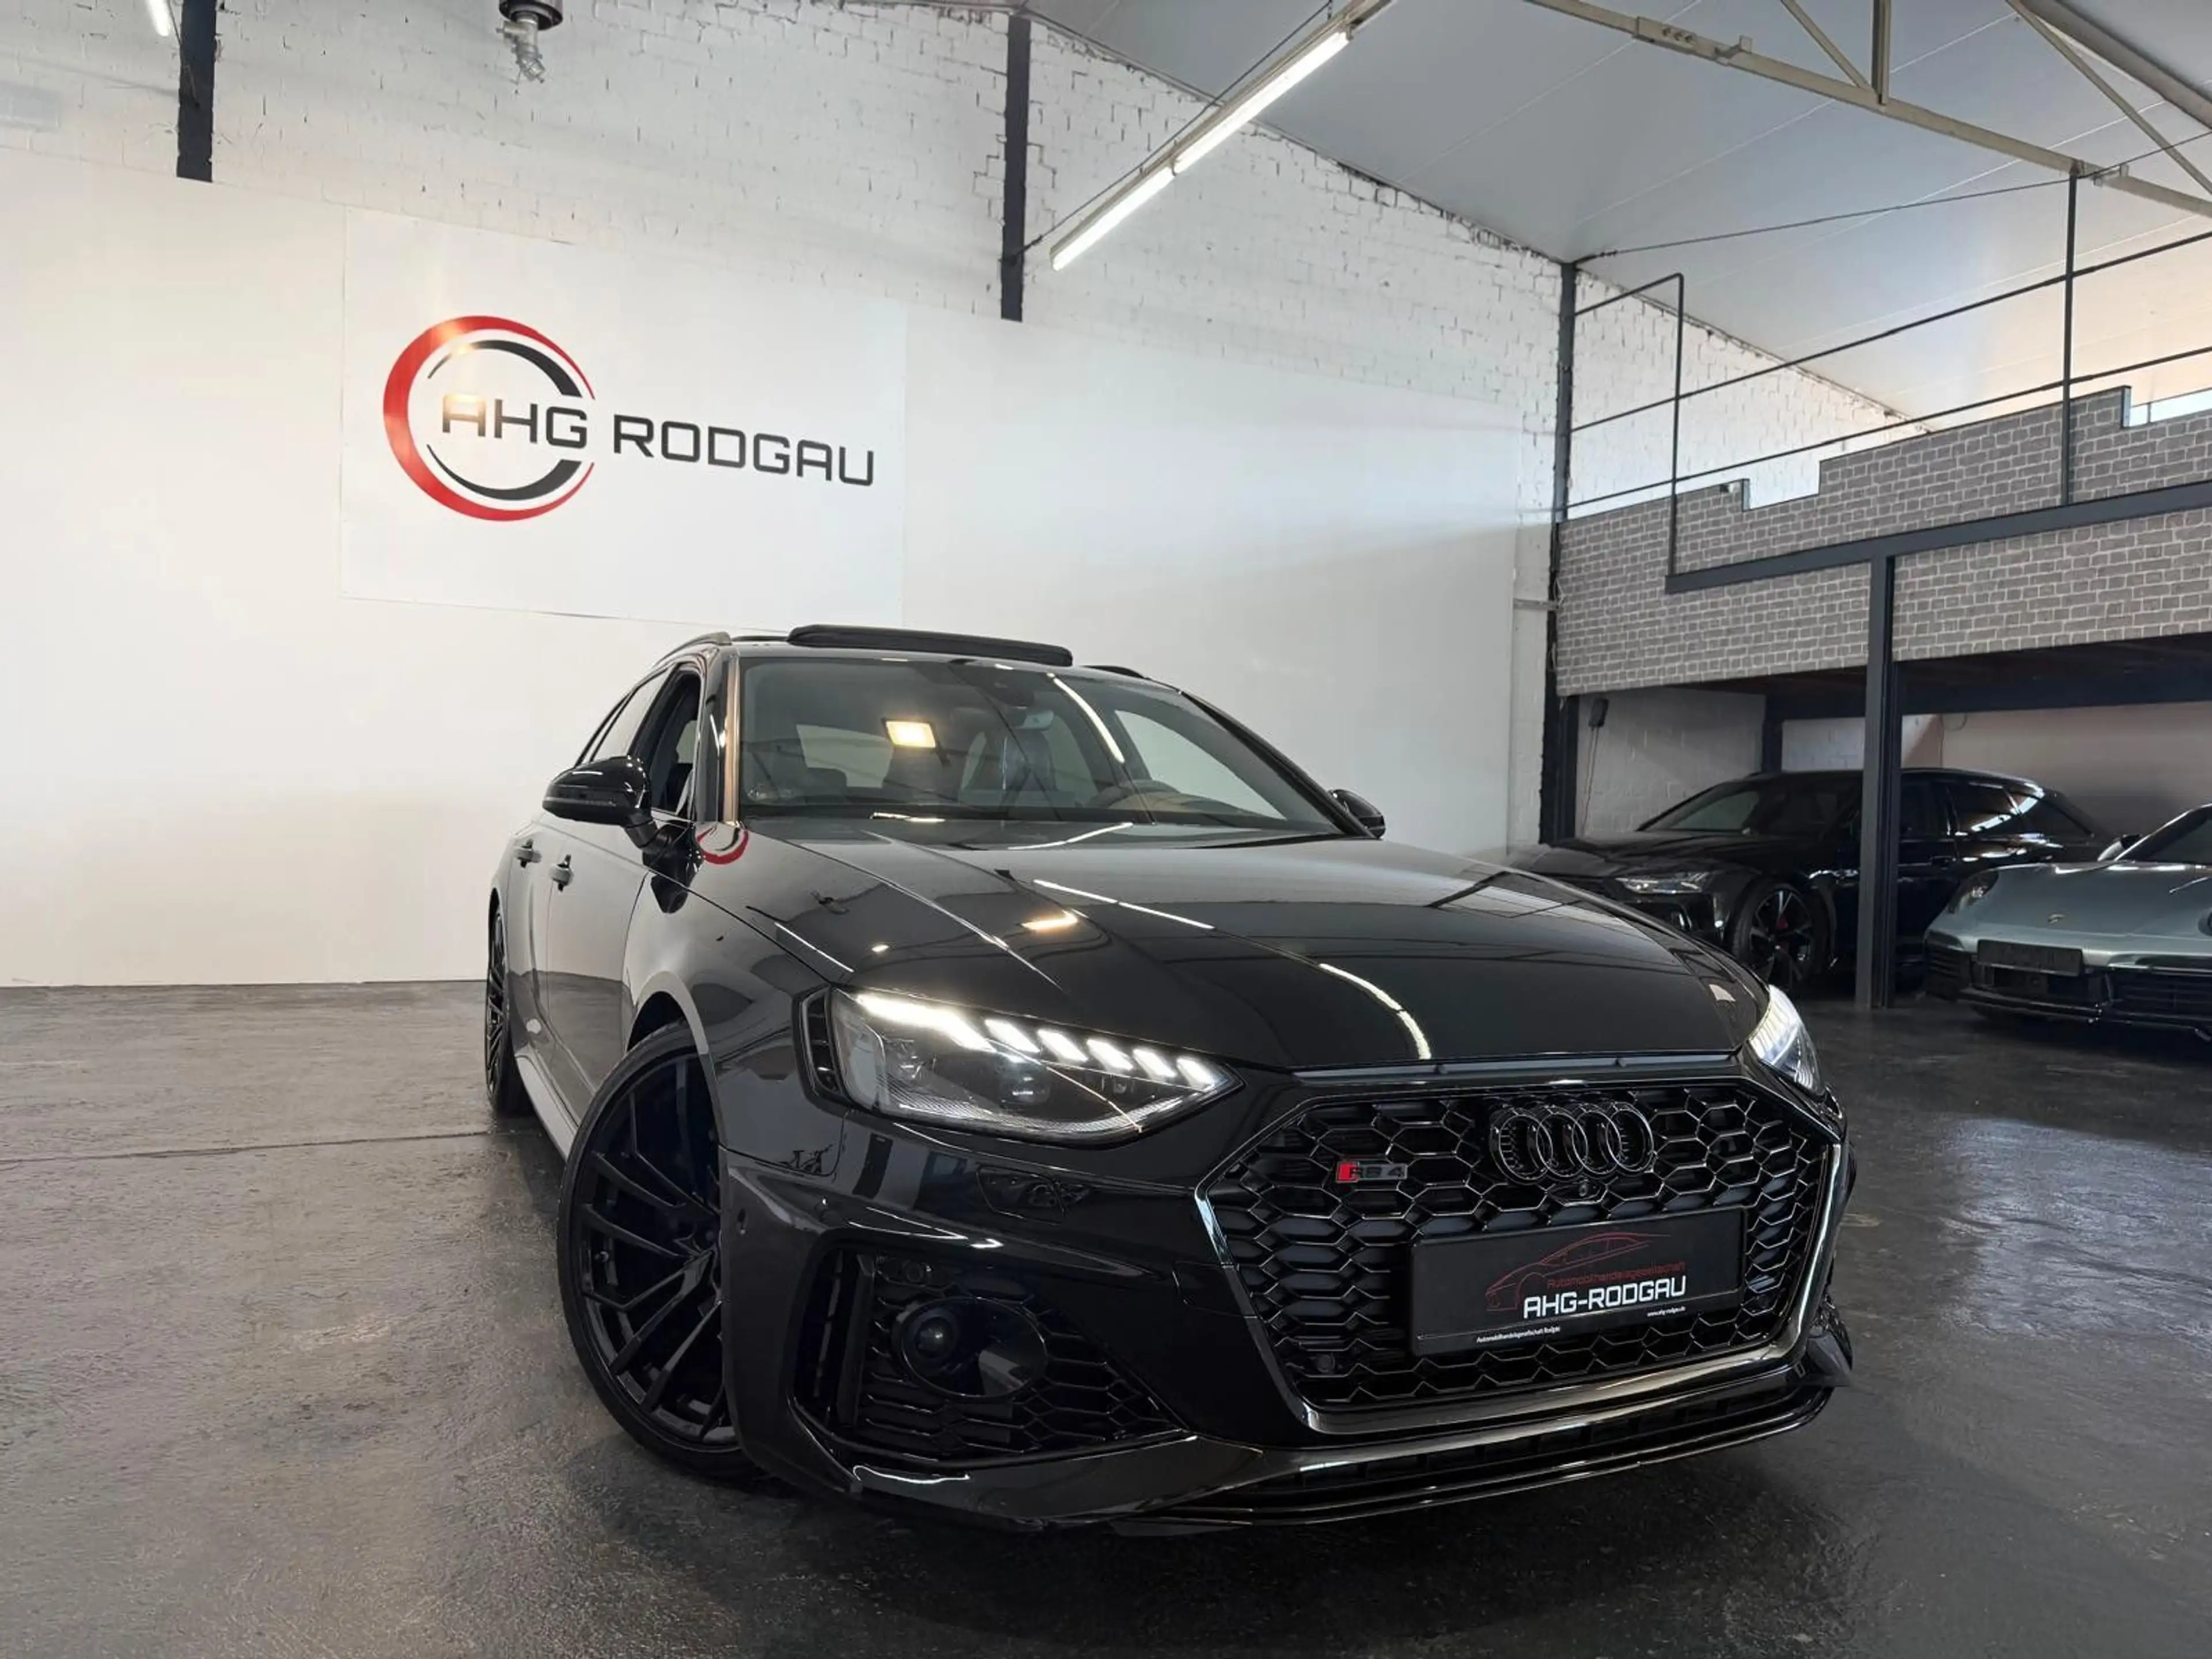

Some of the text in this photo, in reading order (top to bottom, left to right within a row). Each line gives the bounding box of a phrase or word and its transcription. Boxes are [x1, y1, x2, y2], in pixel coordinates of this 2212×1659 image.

[442, 393, 874, 486] AHG RODGAU
[1523, 1275, 1687, 1319] AHG-RODGAU
